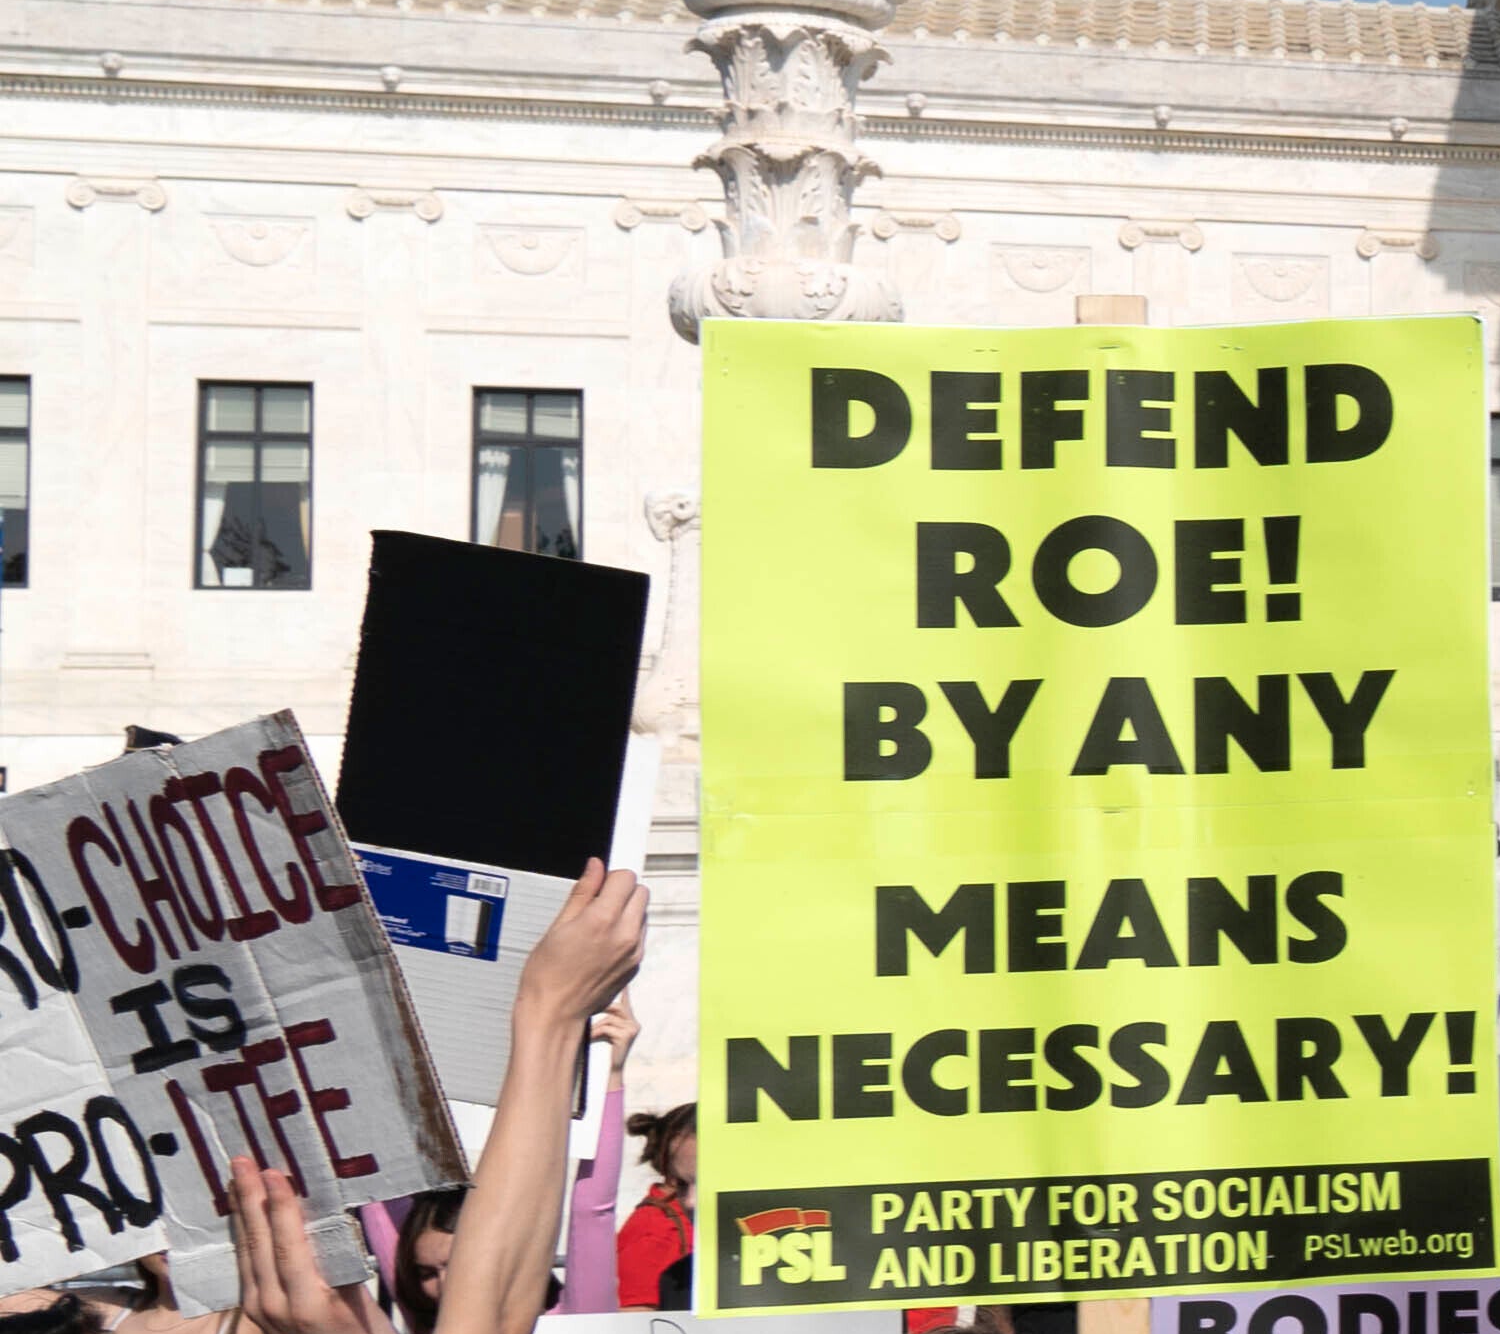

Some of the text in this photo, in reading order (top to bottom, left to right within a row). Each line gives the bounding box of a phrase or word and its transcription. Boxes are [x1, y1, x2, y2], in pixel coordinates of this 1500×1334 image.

[810, 363, 1394, 471] DEFEND
[916, 515, 1302, 629] ROE!
[843, 670, 1396, 781] BY ANY
[874, 871, 1347, 977] MEANS
[110, 964, 247, 1074] IS
[725, 1011, 1476, 1123] NECESSARY!
[741, 1227, 846, 1287] PSL
[871, 1171, 1401, 1235] PARTY FOR SOCIALISM
[869, 1229, 1474, 1291] AND LIBERATION PSLweb.org
